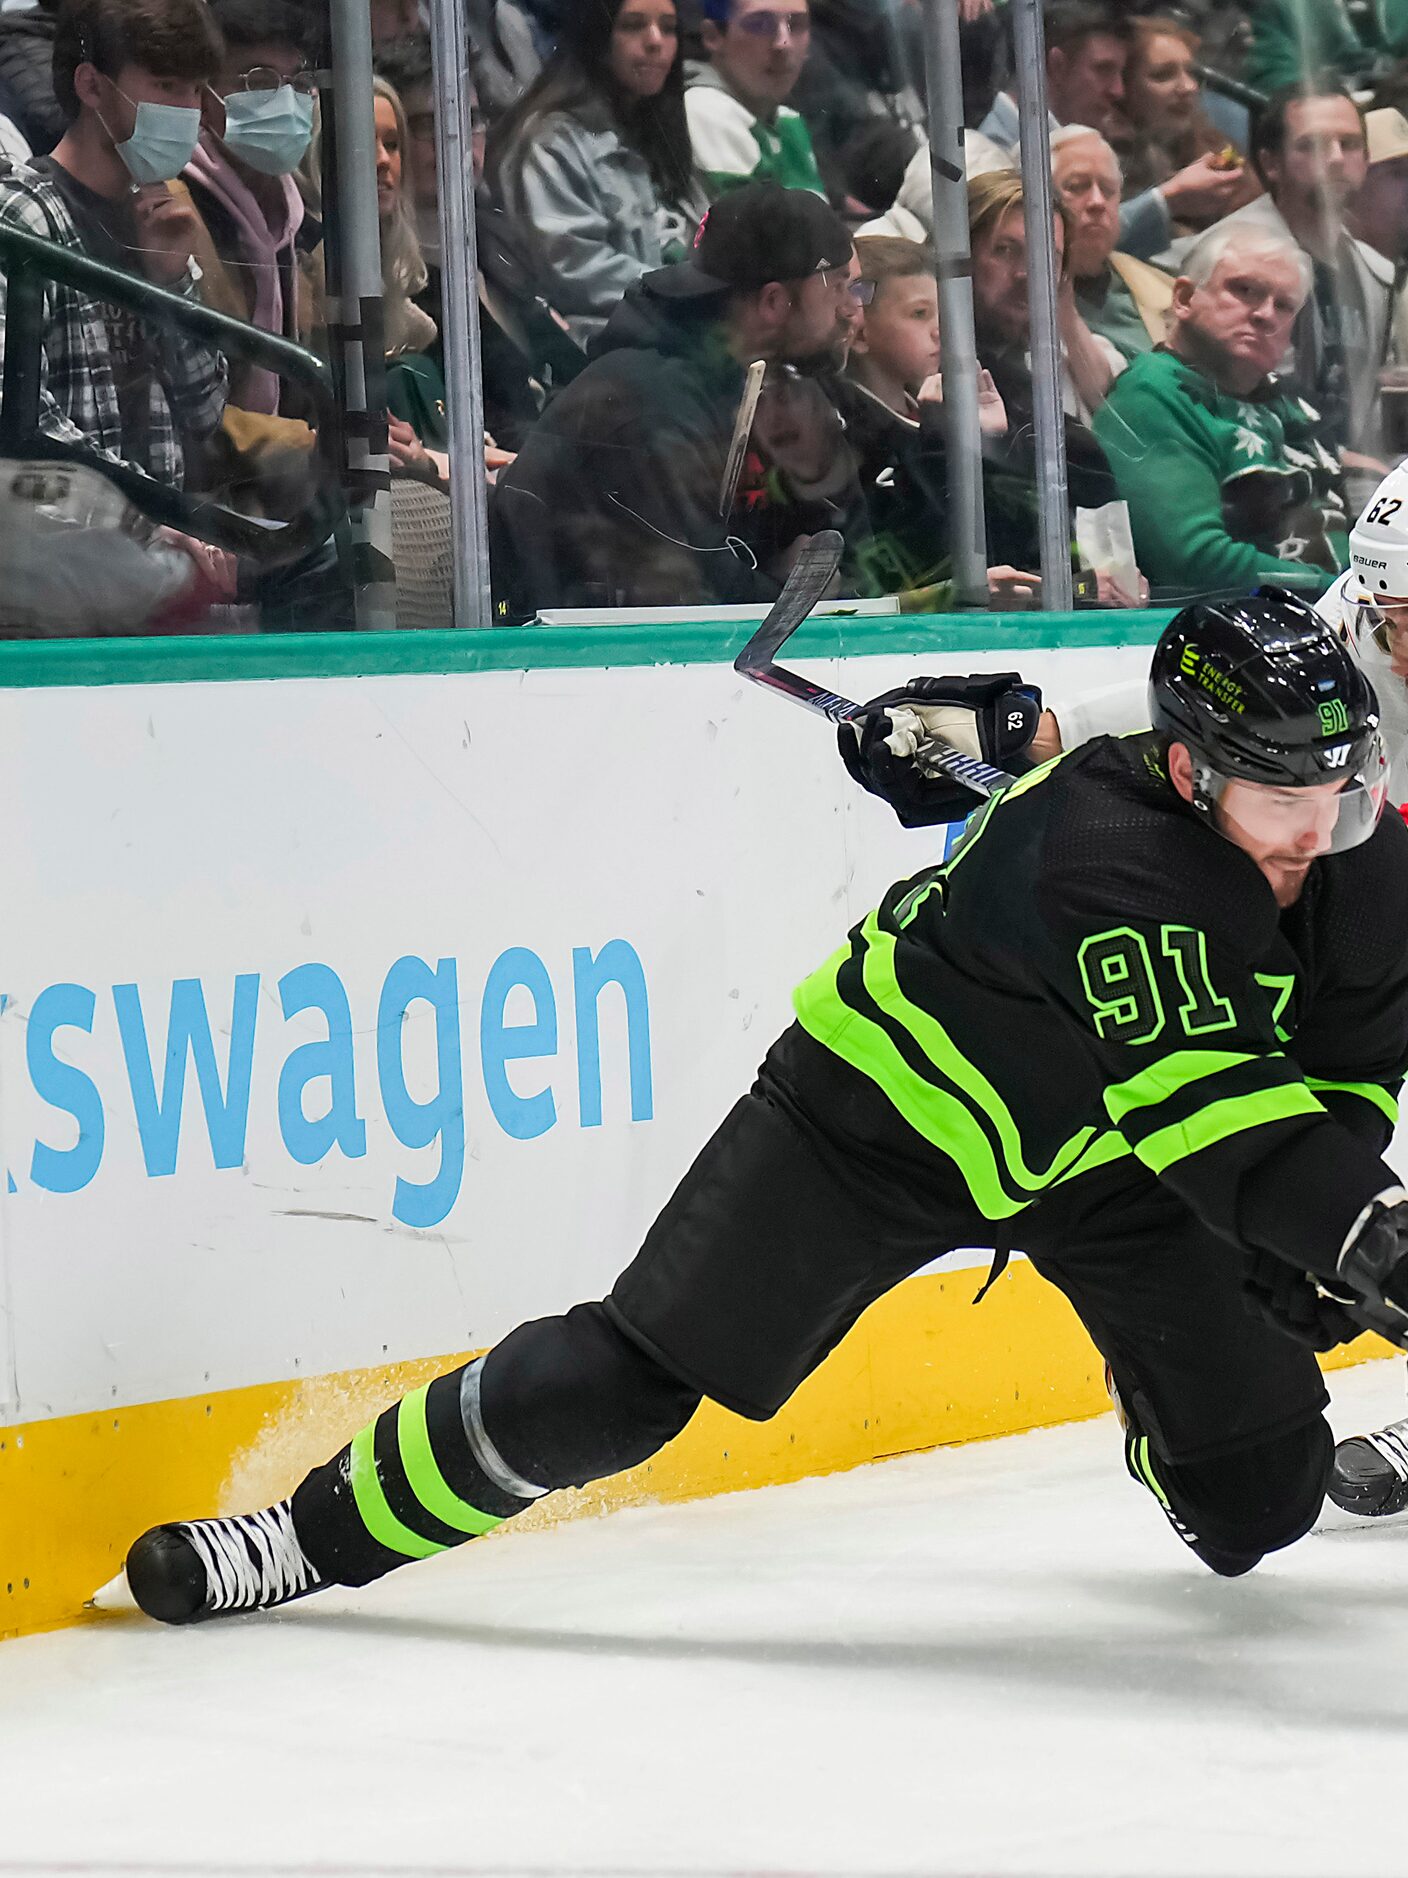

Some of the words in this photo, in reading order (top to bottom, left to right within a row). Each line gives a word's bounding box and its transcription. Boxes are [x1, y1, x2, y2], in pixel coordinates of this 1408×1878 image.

[1366, 497, 1403, 526] 62
[1197, 672, 1247, 716] TRANSFER
[1200, 662, 1243, 697] ENERGY
[1007, 710, 1024, 731] 62
[1317, 697, 1350, 737] 91
[1076, 923, 1238, 1047] 91
[0, 938, 654, 1228] swagen
